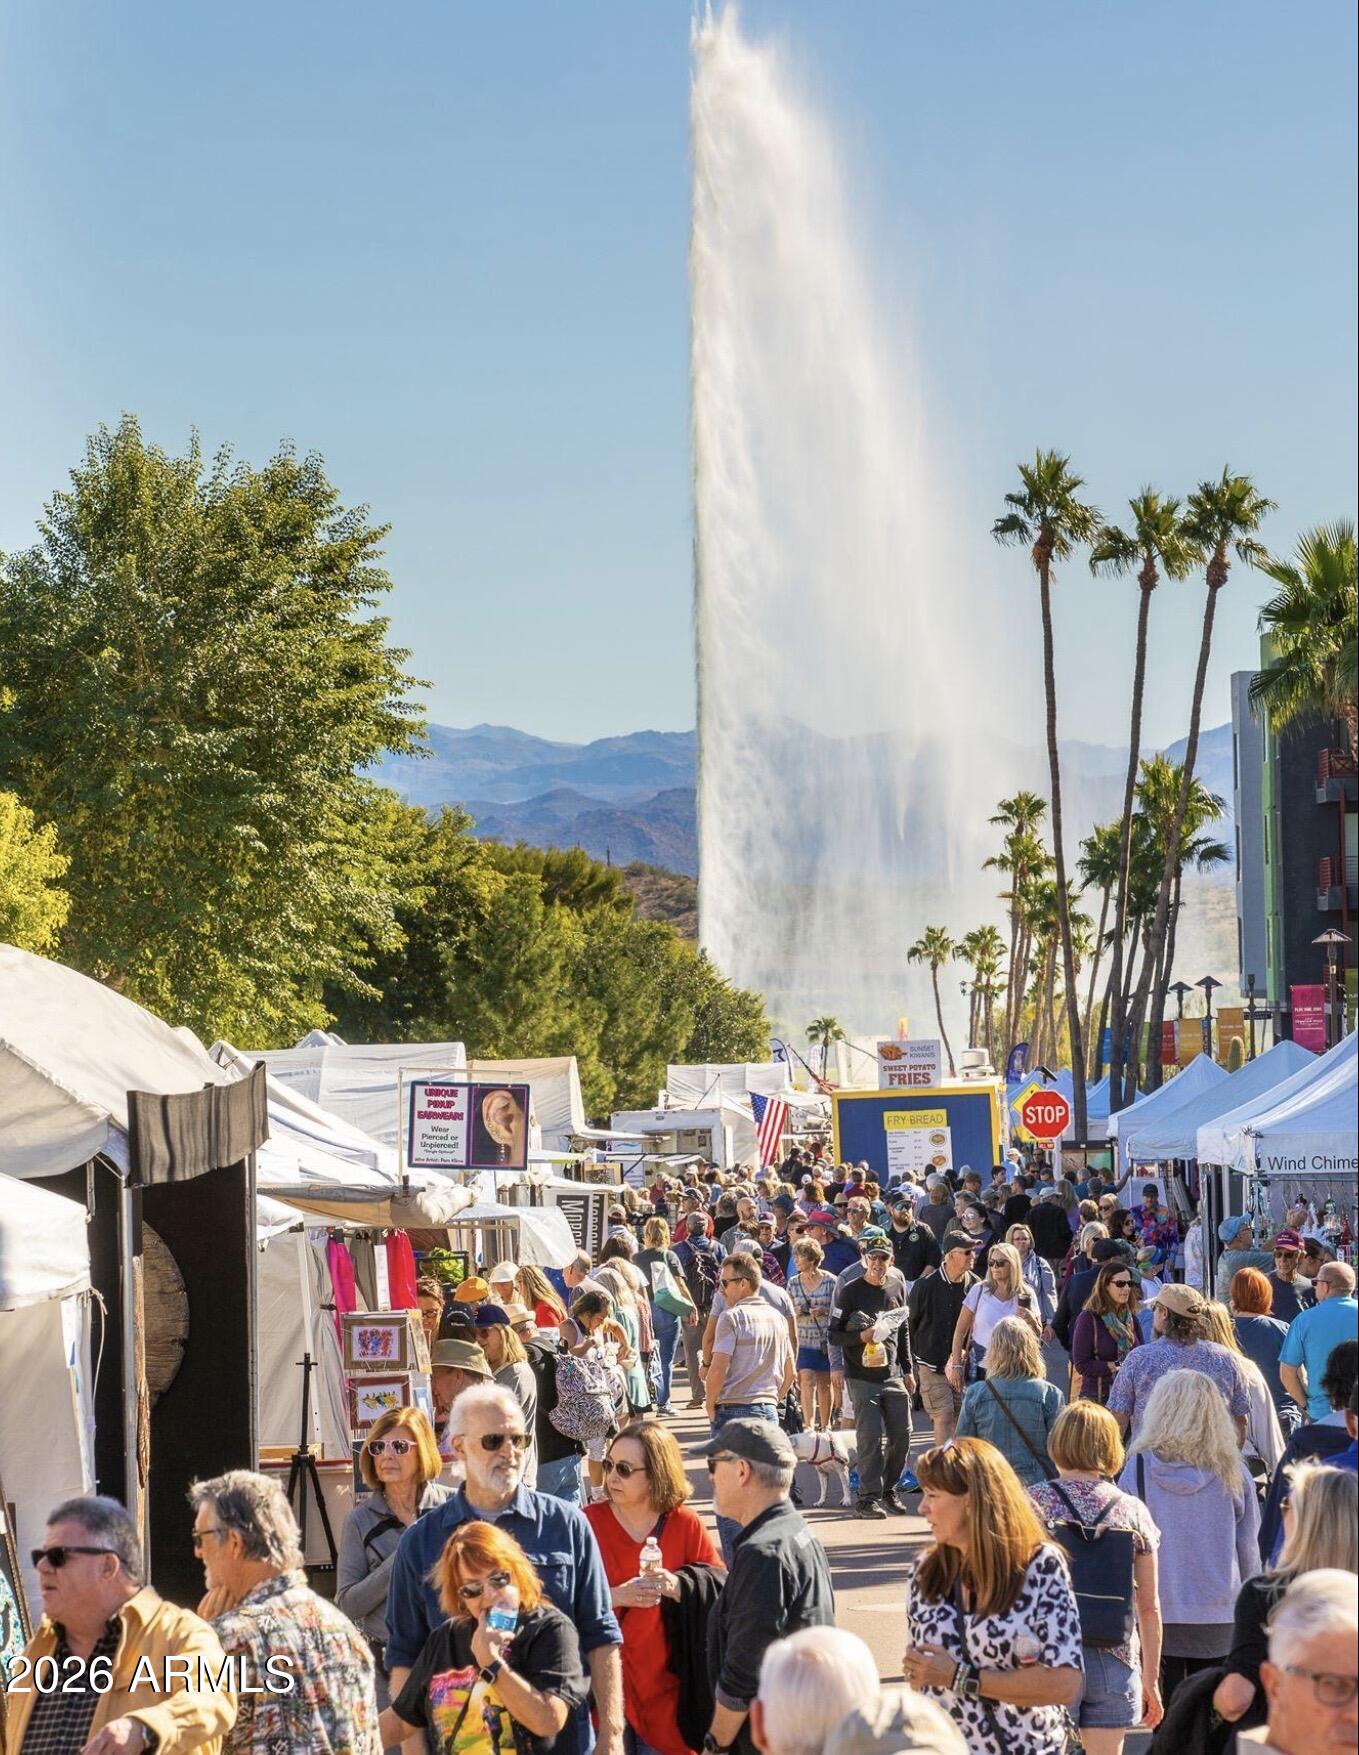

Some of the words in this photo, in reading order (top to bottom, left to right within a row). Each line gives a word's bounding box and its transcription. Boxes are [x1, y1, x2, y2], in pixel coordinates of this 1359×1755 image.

[888, 1072, 931, 1085] FRIES
[424, 1088, 458, 1098] UNIQUE
[887, 1115, 907, 1125] FRY
[910, 1113, 944, 1125] BREAD
[1026, 1105, 1066, 1124] STOP
[420, 1141, 459, 1149] Unpierced!
[1267, 1156, 1306, 1170] Wind
[1311, 1155, 1358, 1169] Chime
